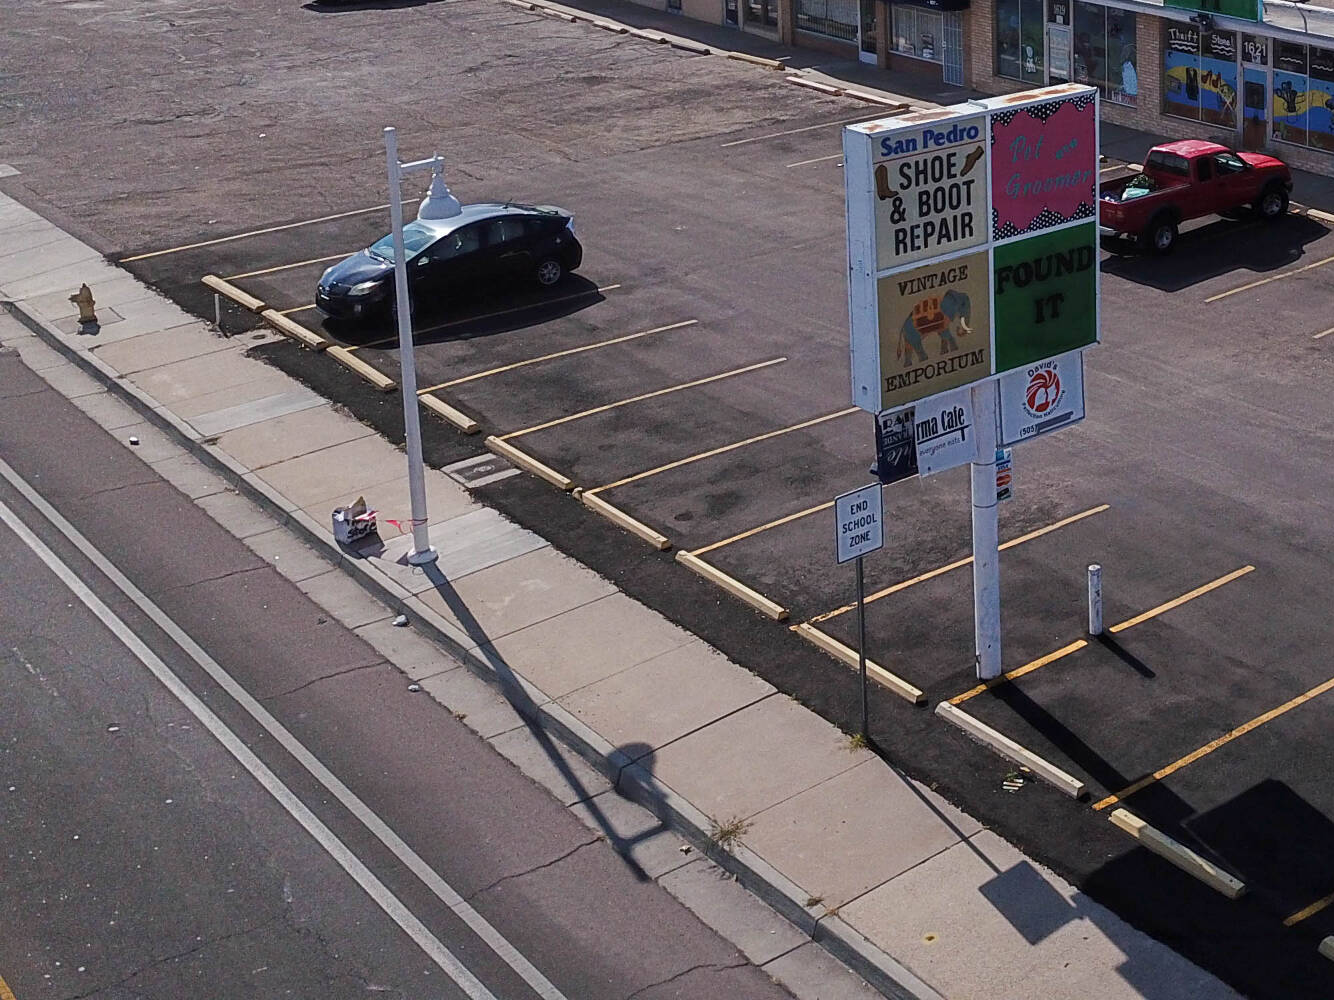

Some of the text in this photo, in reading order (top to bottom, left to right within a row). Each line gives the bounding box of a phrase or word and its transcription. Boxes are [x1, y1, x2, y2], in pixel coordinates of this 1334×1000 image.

[1241, 41, 1265, 57] 1621
[881, 124, 979, 158] San Pedro
[899, 152, 957, 190] SHOE
[890, 179, 975, 225] & BOOT
[895, 211, 974, 256] REPAIR
[897, 265, 968, 297] VINTAGE
[995, 245, 1094, 295] FOUND
[1034, 293, 1064, 324] IT
[885, 349, 985, 393] EMPORIUM
[1028, 360, 1058, 377] David's
[940, 405, 965, 432] Cafe
[920, 442, 946, 456] everyone
[850, 500, 868, 515] END
[842, 514, 877, 534] SCHOOL
[849, 532, 871, 548] ZONE
